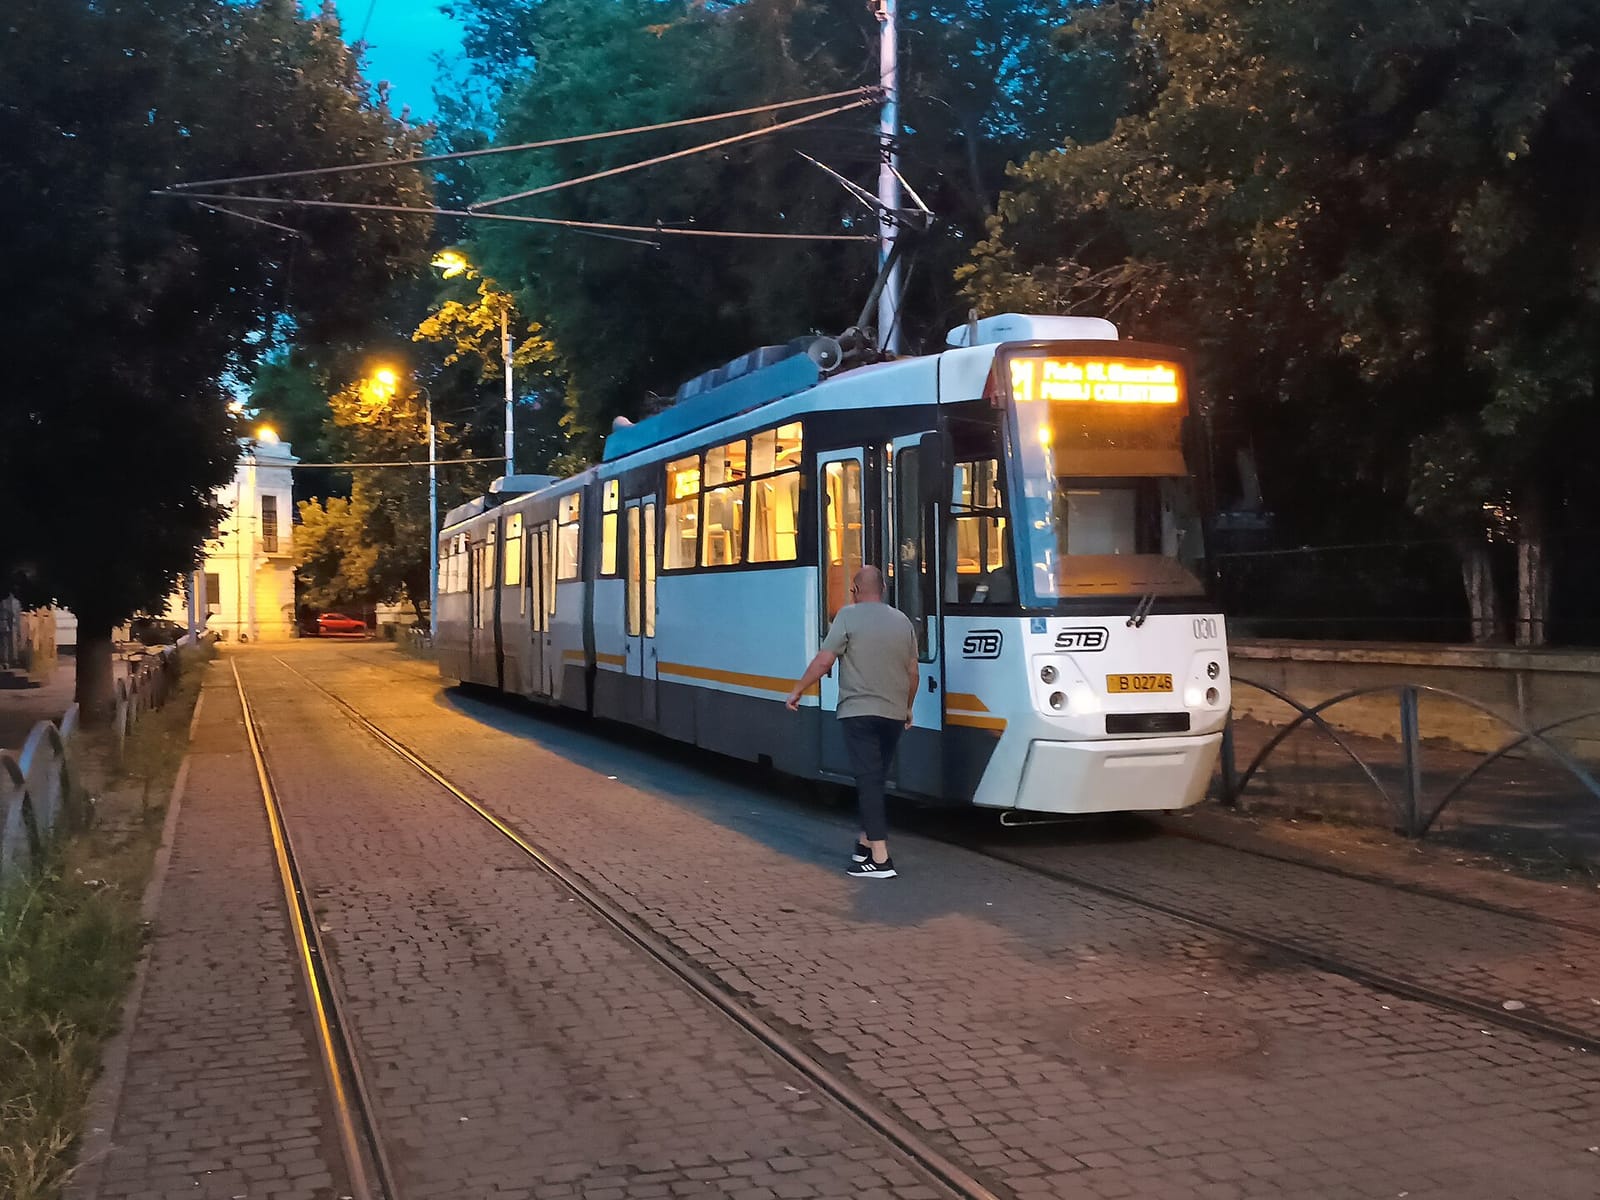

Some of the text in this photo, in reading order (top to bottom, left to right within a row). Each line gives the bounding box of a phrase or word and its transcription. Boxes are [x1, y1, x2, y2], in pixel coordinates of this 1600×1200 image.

[1193, 618, 1217, 639] 030
[963, 635, 999, 653] STB
[1055, 632, 1103, 647] STB
[1119, 676, 1129, 690] B
